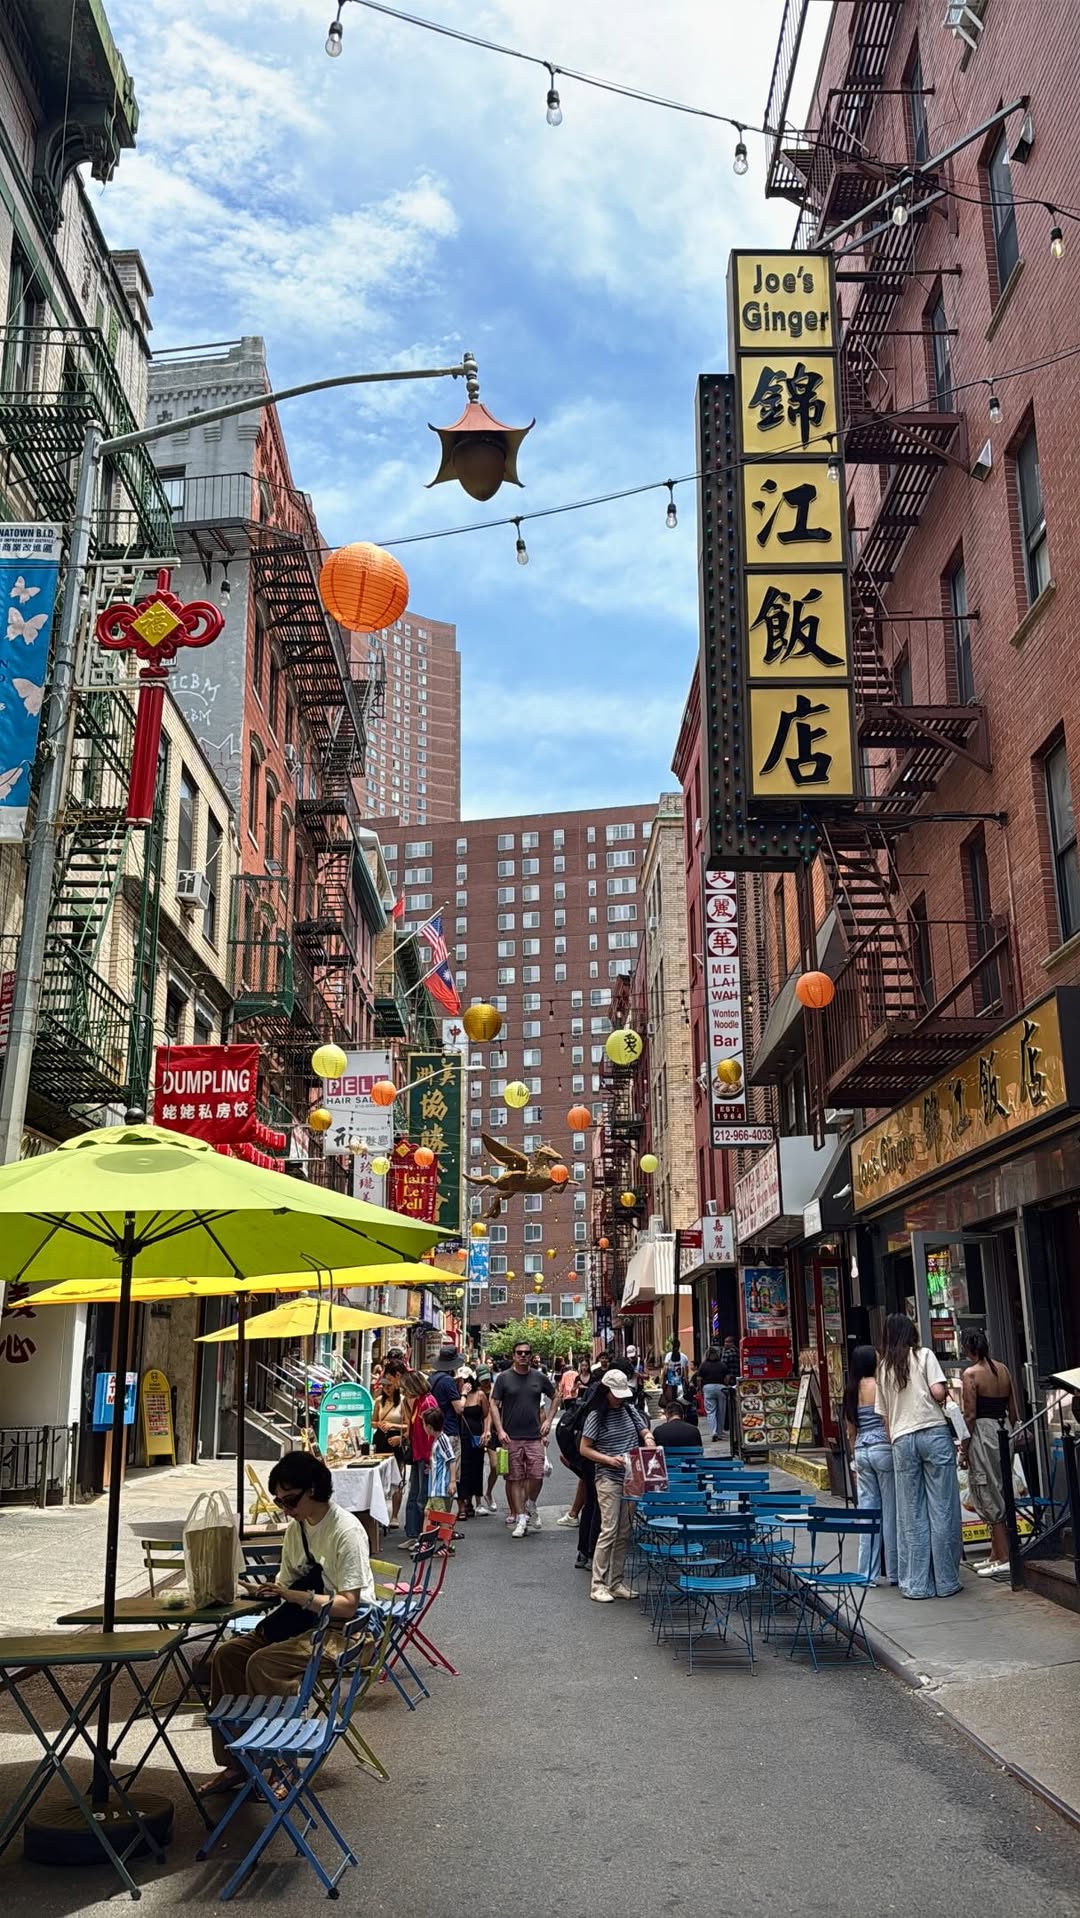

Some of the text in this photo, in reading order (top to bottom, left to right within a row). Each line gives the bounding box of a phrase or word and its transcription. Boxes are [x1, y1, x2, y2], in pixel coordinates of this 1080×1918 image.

[753, 264, 815, 294] Joe's
[742, 301, 830, 338] Ginger
[748, 362, 846, 786] 錦江飯店
[139, 608, 168, 636] 福
[711, 964, 736, 974] MEI
[712, 977, 735, 988] LAI
[711, 991, 738, 1000] WAH
[712, 1009, 739, 1018] Wonton
[714, 1021, 739, 1029] Noodle
[713, 1034, 739, 1047] Bar
[162, 1069, 250, 1095] DUMPLING
[326, 1097, 351, 1105] HAIR
[714, 1129, 773, 1141] 212-966-4033
